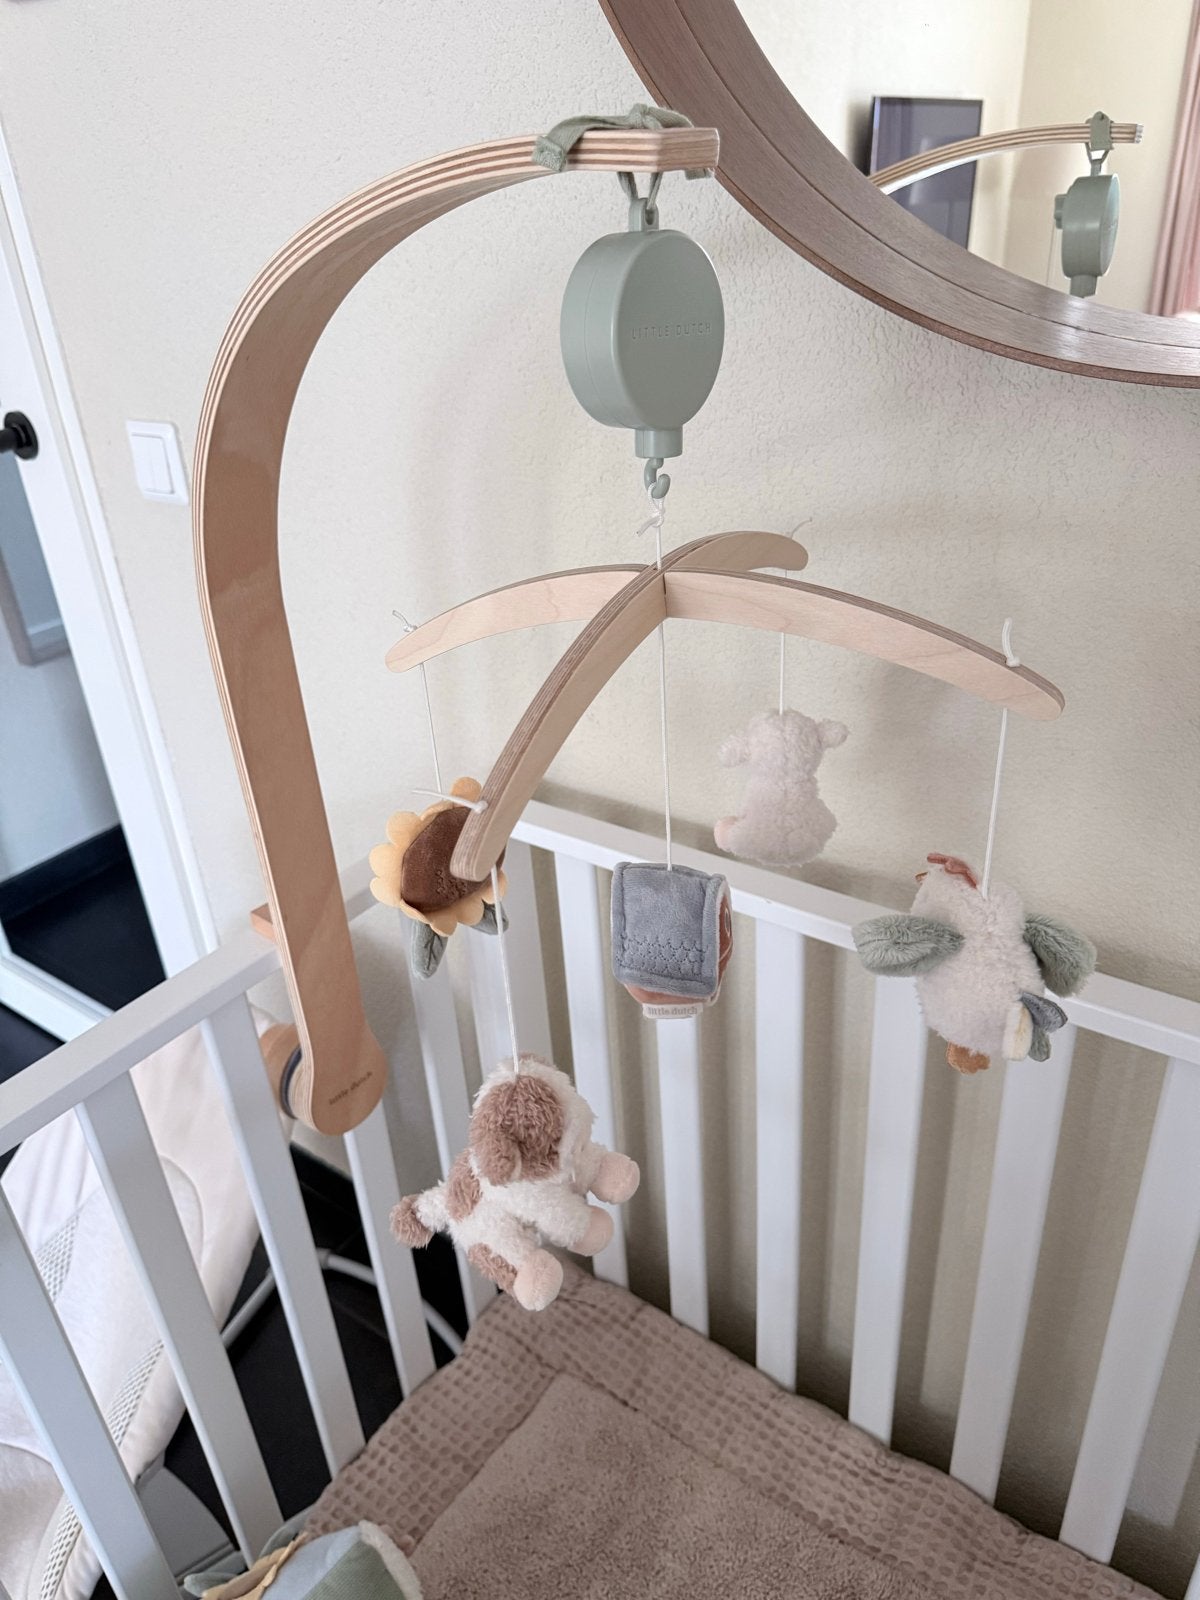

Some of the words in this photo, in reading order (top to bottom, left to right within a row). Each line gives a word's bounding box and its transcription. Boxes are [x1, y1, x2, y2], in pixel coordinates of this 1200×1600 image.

[632, 325, 670, 340] LITTLE
[676, 322, 711, 335] DUTCH
[648, 1006, 670, 1015] little
[671, 1006, 698, 1015] dutch
